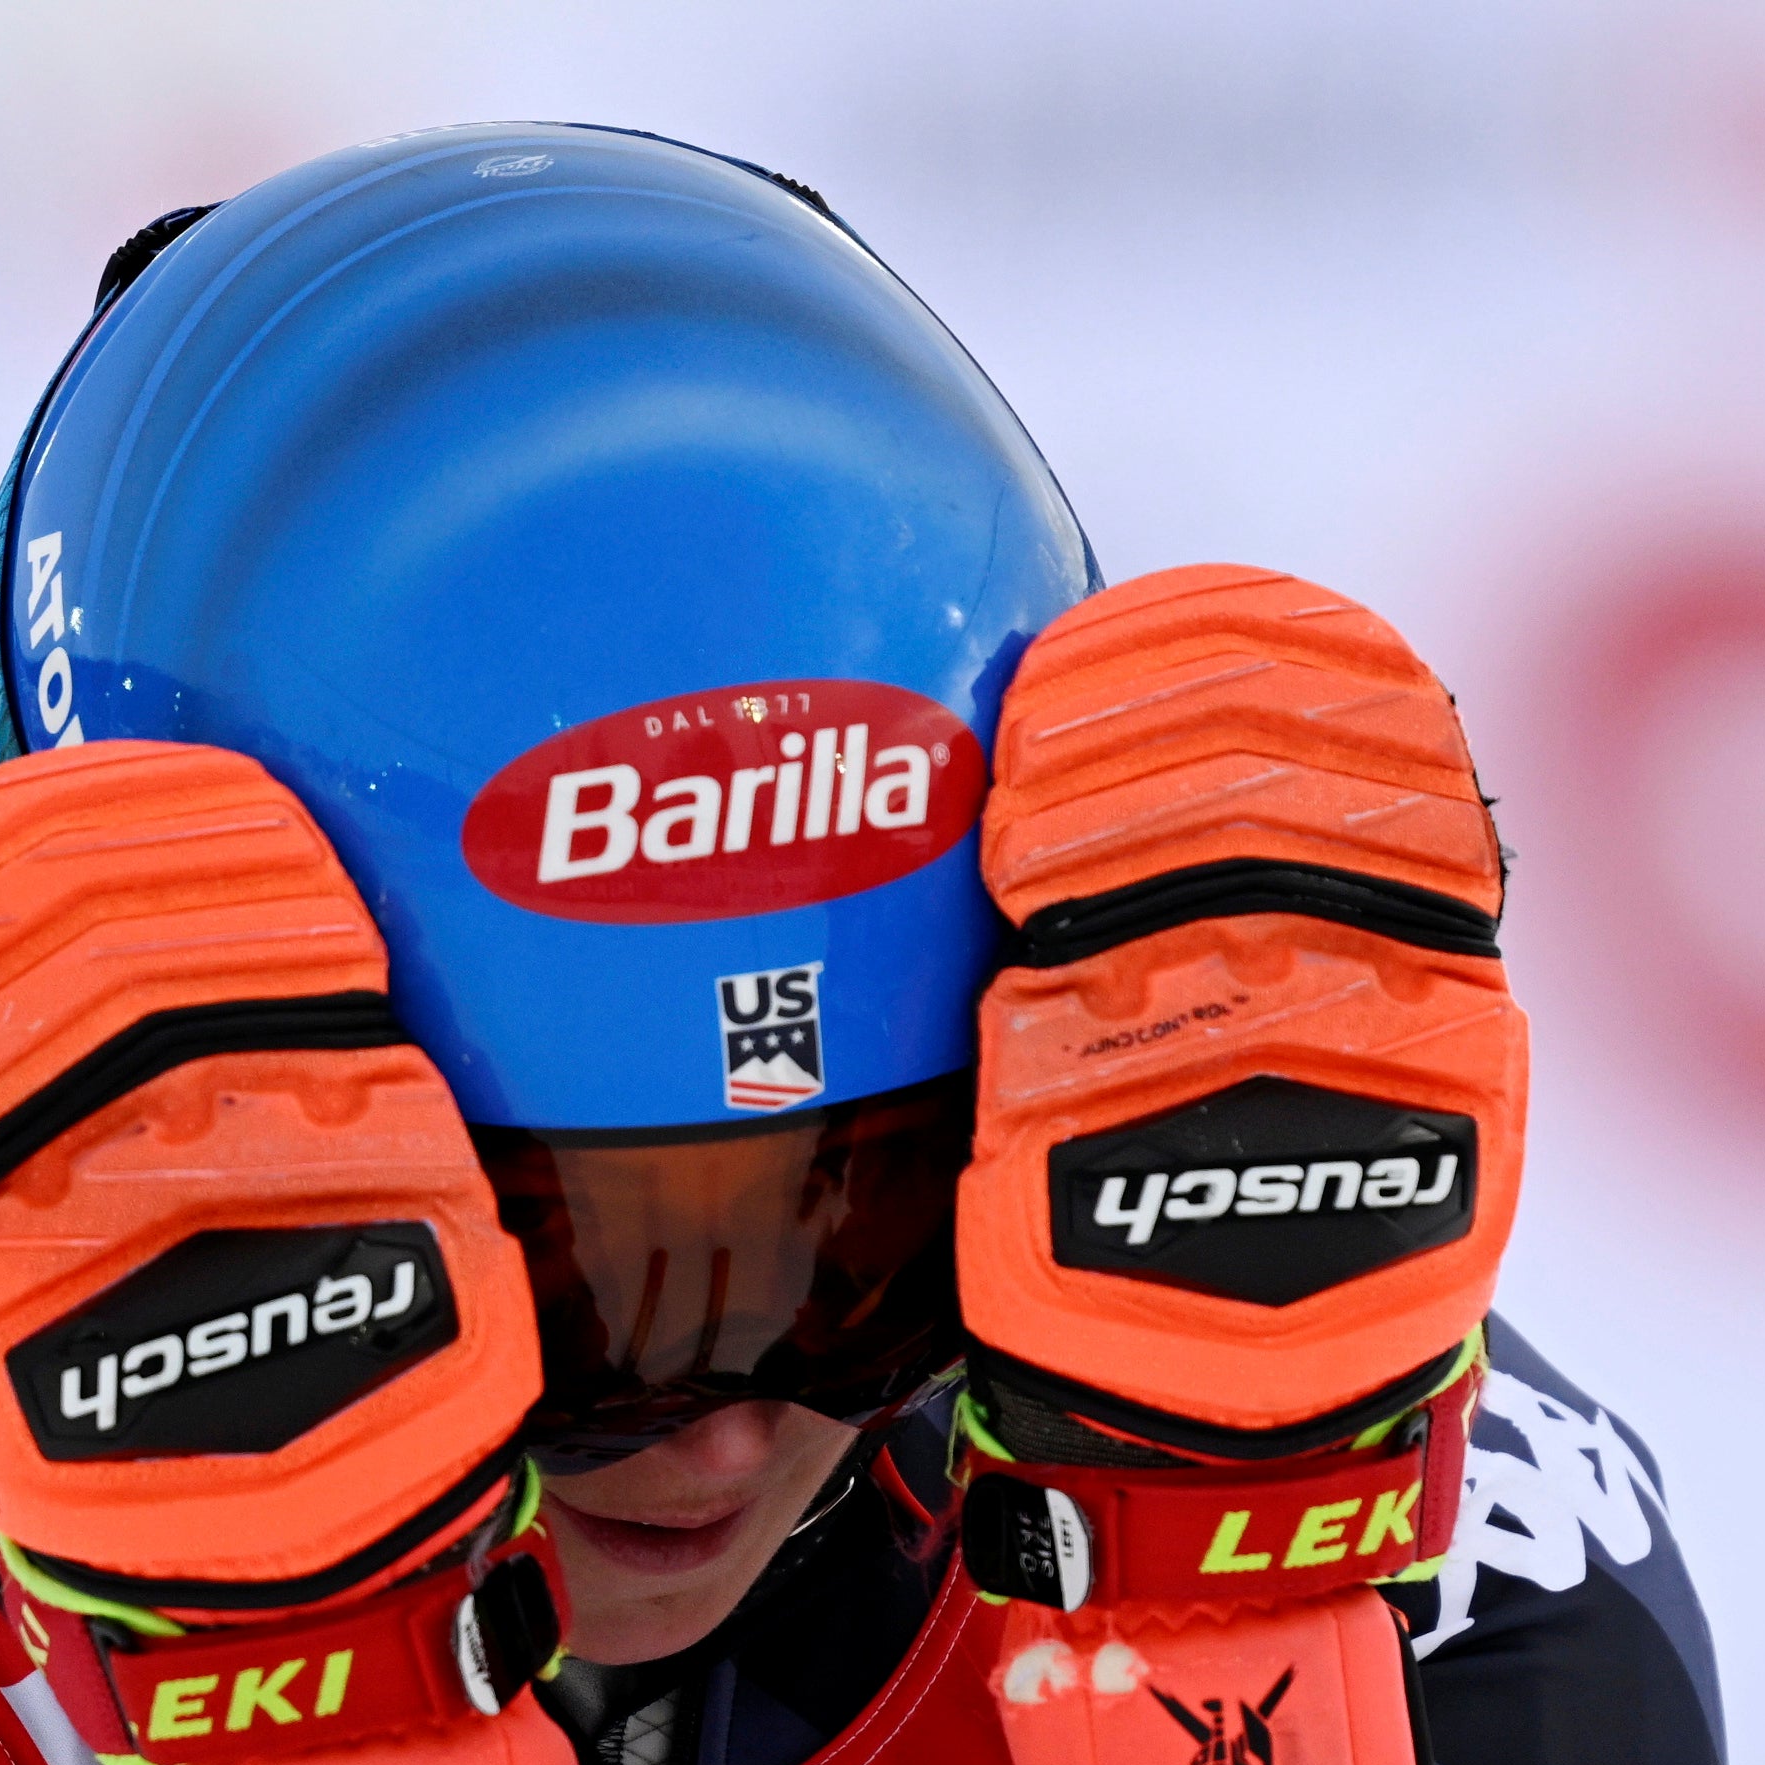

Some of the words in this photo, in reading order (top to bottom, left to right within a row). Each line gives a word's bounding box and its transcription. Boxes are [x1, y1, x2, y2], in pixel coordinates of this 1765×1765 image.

[27, 530, 85, 748] ATO
[643, 704, 715, 738] DAL
[731, 692, 811, 722] 1877
[537, 723, 933, 883] Barilla
[720, 969, 816, 1026] US
[1093, 1153, 1459, 1245] reusch
[60, 1260, 418, 1431] reusch
[128, 1649, 354, 1743] EKI
